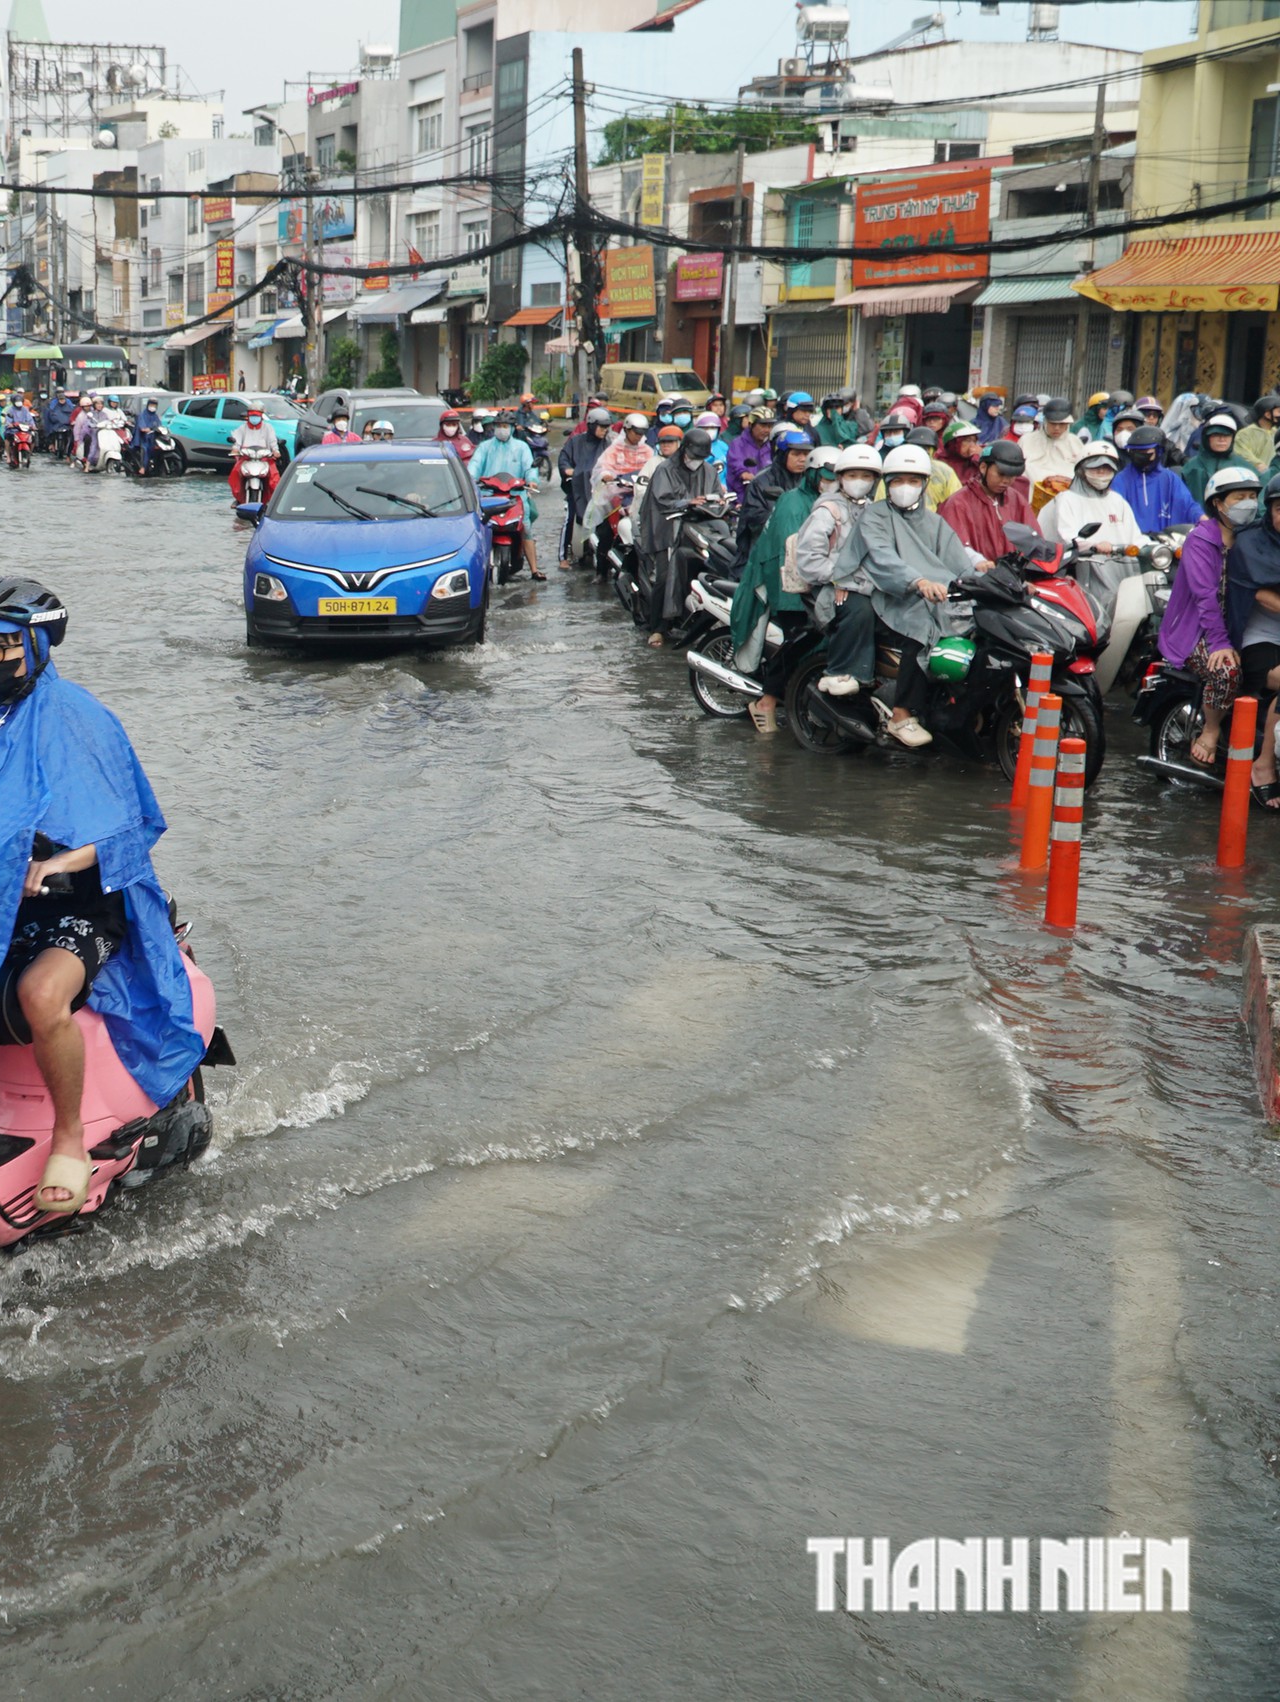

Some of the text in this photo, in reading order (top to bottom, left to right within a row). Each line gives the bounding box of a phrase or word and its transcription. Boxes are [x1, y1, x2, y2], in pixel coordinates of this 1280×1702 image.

[863, 206, 897, 223] TRUNG
[898, 197, 921, 219] TÂM
[941, 190, 979, 214] THUẬT
[325, 600, 389, 612] 50H-871.24
